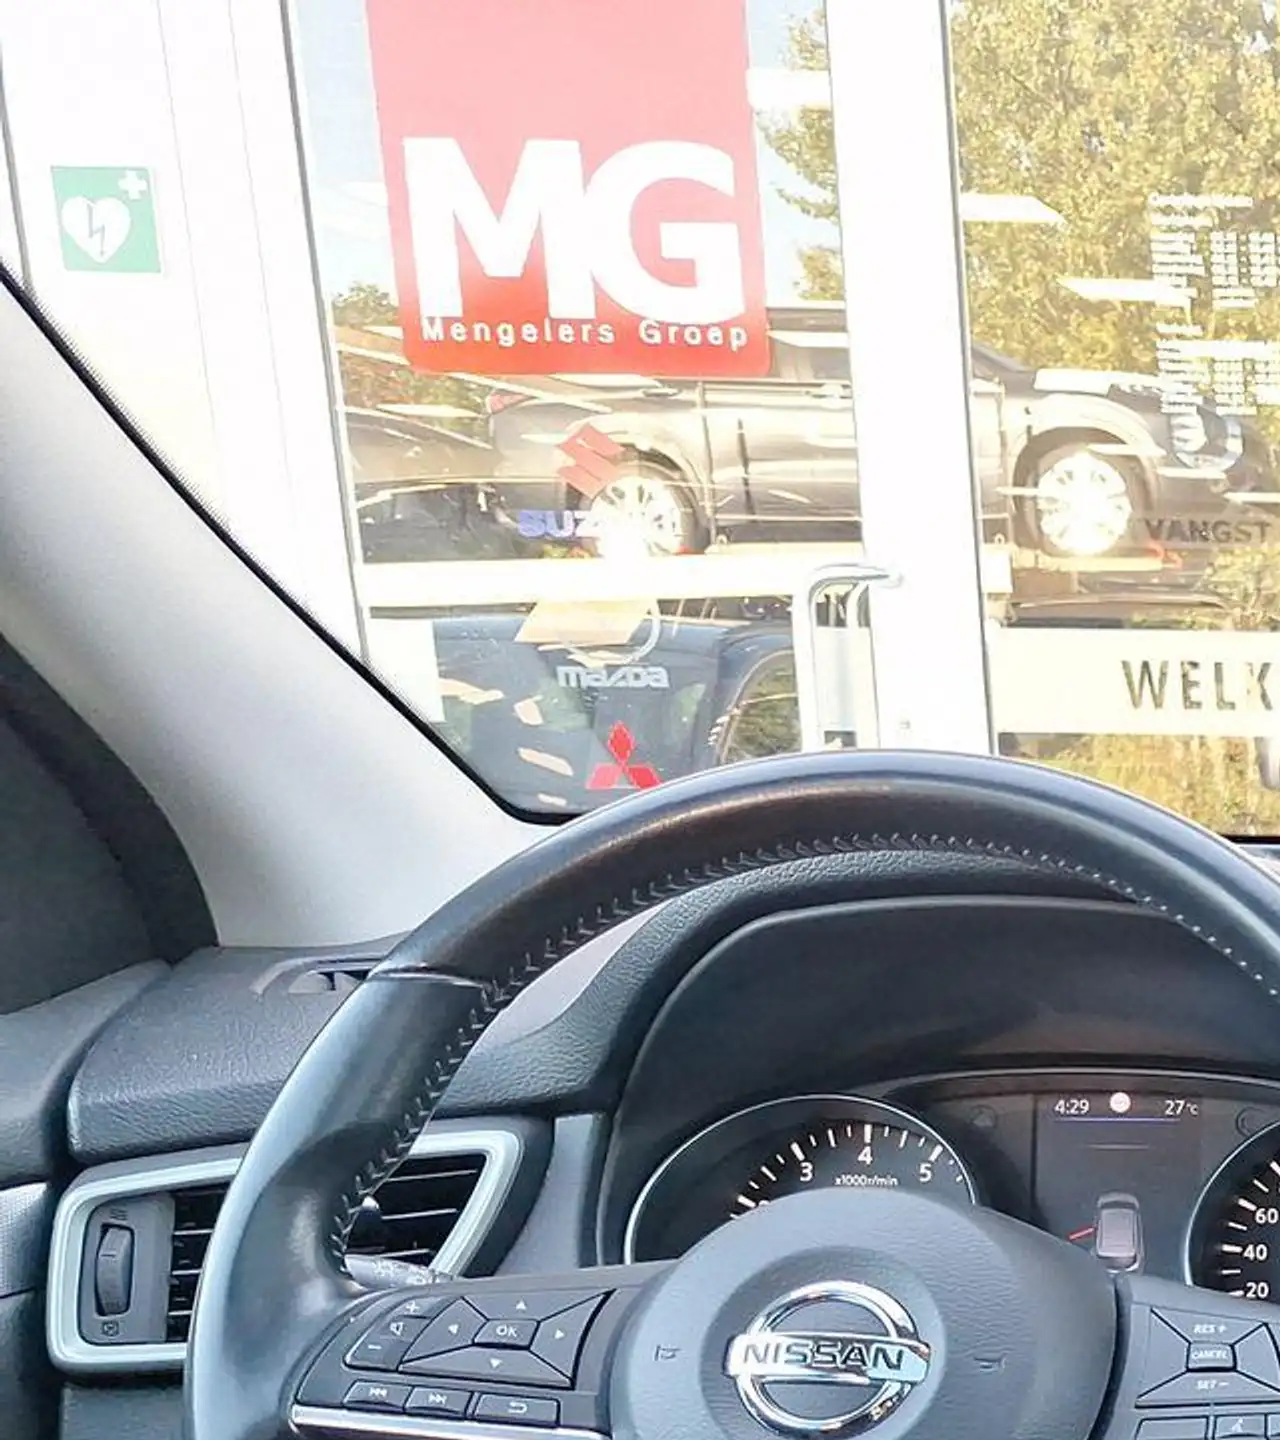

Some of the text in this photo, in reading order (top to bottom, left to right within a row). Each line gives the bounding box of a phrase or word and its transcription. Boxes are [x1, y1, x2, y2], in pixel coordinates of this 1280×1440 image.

[402, 137, 746, 325] MG
[421, 318, 748, 351] Mengelers Groep
[556, 666, 670, 688] mazda
[1053, 1100, 1091, 1116] 4:29
[857, 1146, 874, 1166] 4
[799, 1163, 815, 1183] 3
[919, 1163, 933, 1183] 5
[1255, 1208, 1279, 1225] 60
[1243, 1244, 1268, 1261] 40
[1245, 1282, 1269, 1298] 20
[495, 1325, 518, 1338] OK
[742, 1342, 904, 1372] NISSAN
